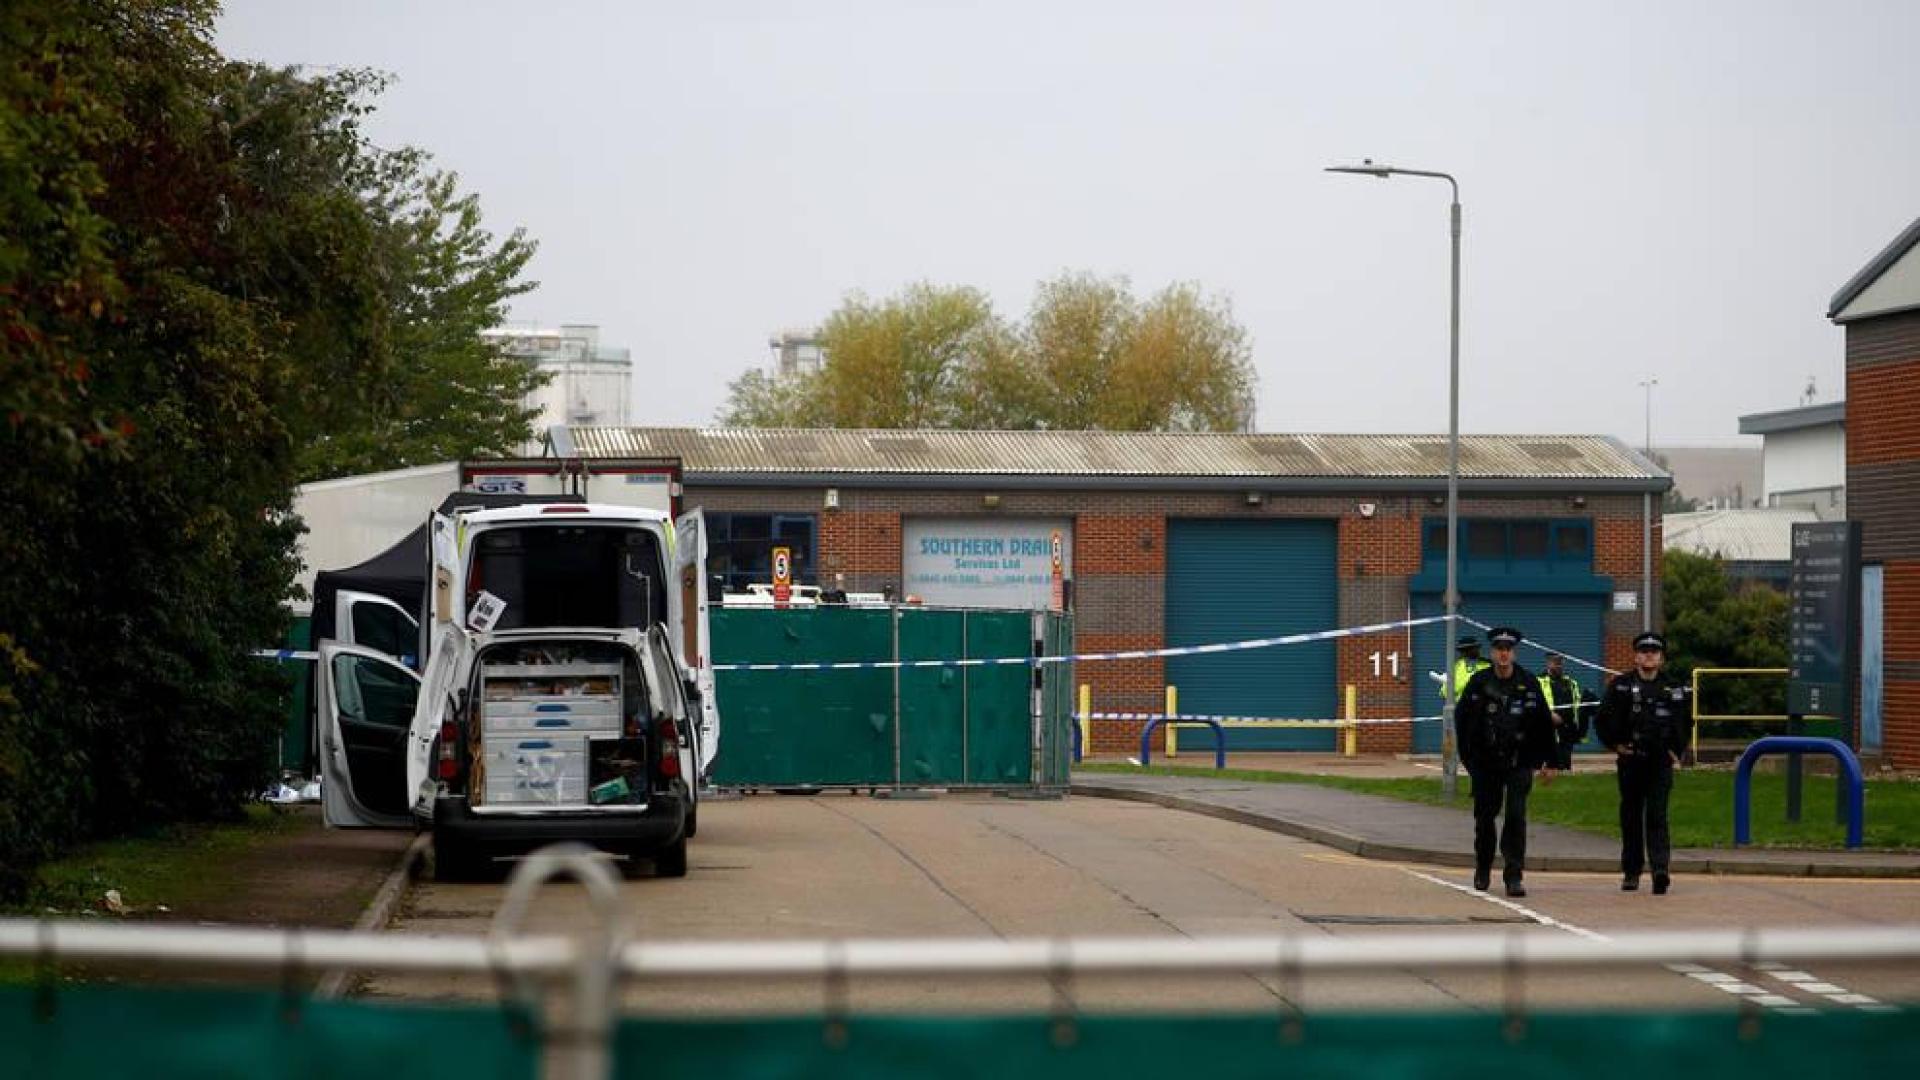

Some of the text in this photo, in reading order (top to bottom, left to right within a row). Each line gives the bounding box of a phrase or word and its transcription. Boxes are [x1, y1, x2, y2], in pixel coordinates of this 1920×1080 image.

[920, 537, 1004, 555] SOUTHERN
[1010, 537, 1052, 555] DRAI
[955, 558, 1021, 569] Services Ltd
[1368, 651, 1398, 676] 11
